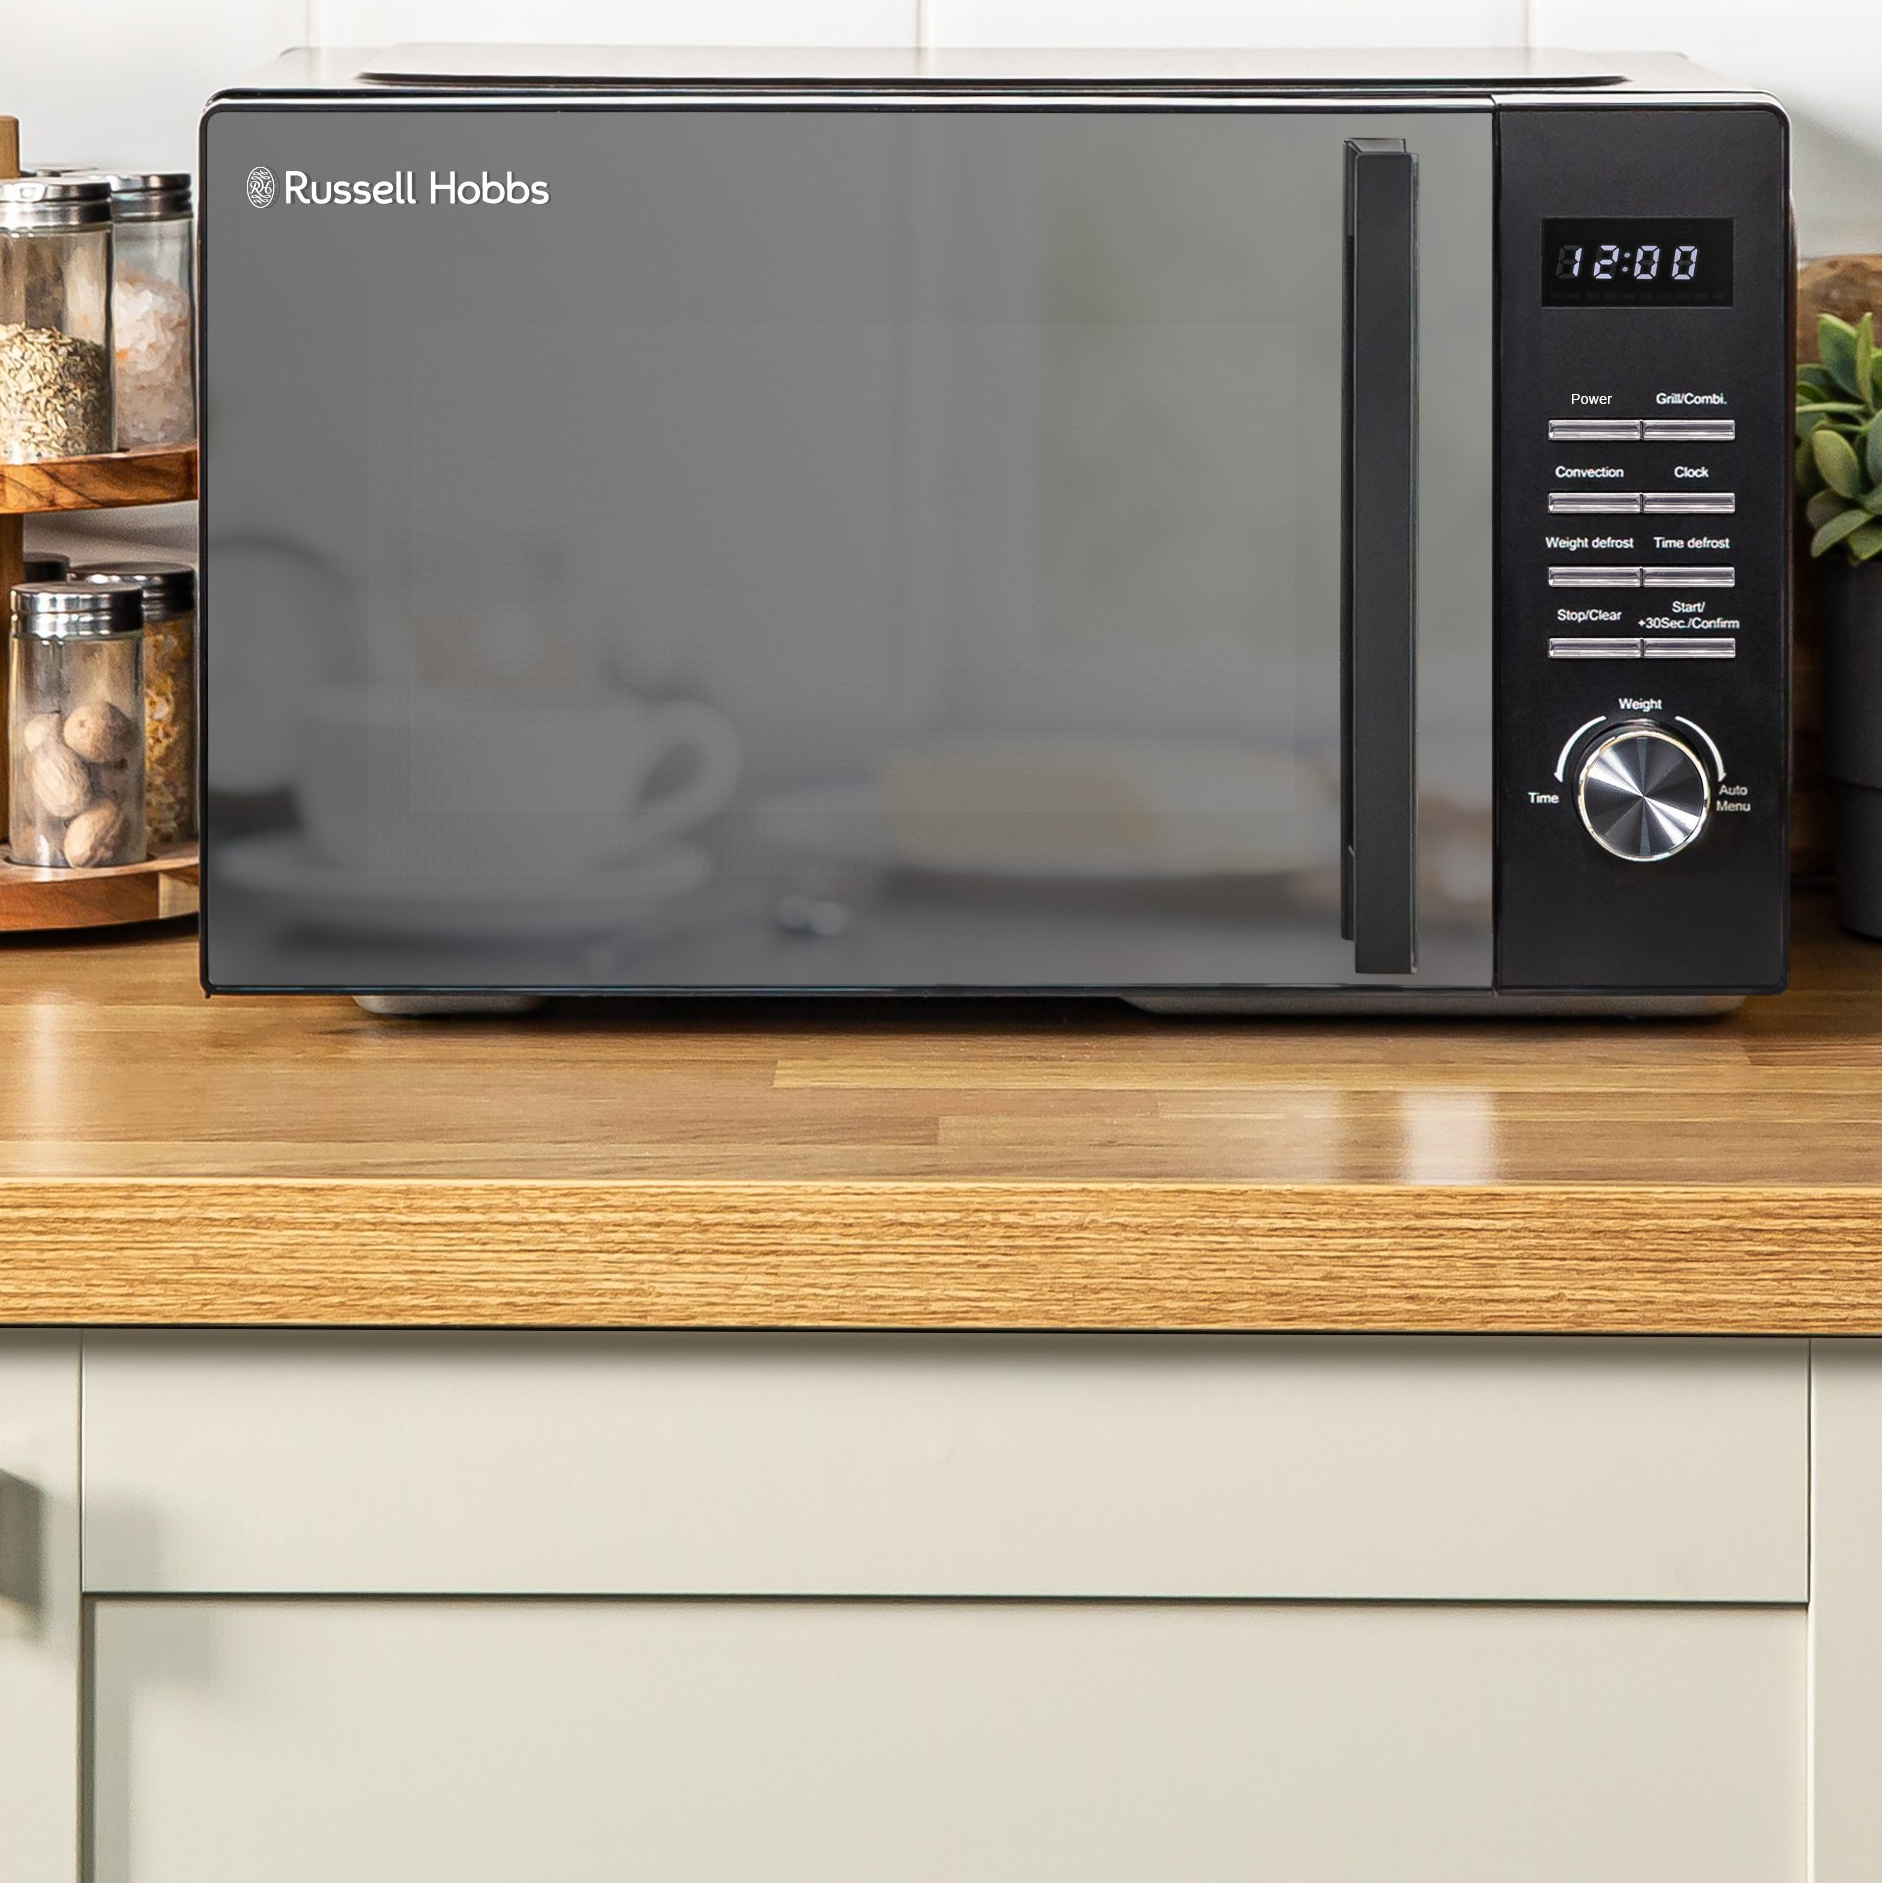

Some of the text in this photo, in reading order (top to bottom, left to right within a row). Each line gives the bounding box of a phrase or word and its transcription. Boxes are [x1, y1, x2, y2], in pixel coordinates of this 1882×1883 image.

[285, 170, 551, 205] Russell Hobbs
[1572, 244, 1699, 280] 12:00
[1571, 393, 1613, 405] Power
[1656, 392, 1727, 405] Grill/Combi.
[1555, 465, 1625, 478] Convection
[1674, 465, 1709, 478] Clock
[1545, 536, 1634, 551] Weight defrost
[1653, 536, 1730, 549] Time defrost
[1672, 600, 1706, 614] Start/
[1557, 609, 1622, 623] Stop/Clear
[1618, 697, 1663, 712] Weight
[1718, 784, 1749, 796] Auto
[1528, 791, 1560, 804] Time
[1716, 800, 1752, 812] Menu
